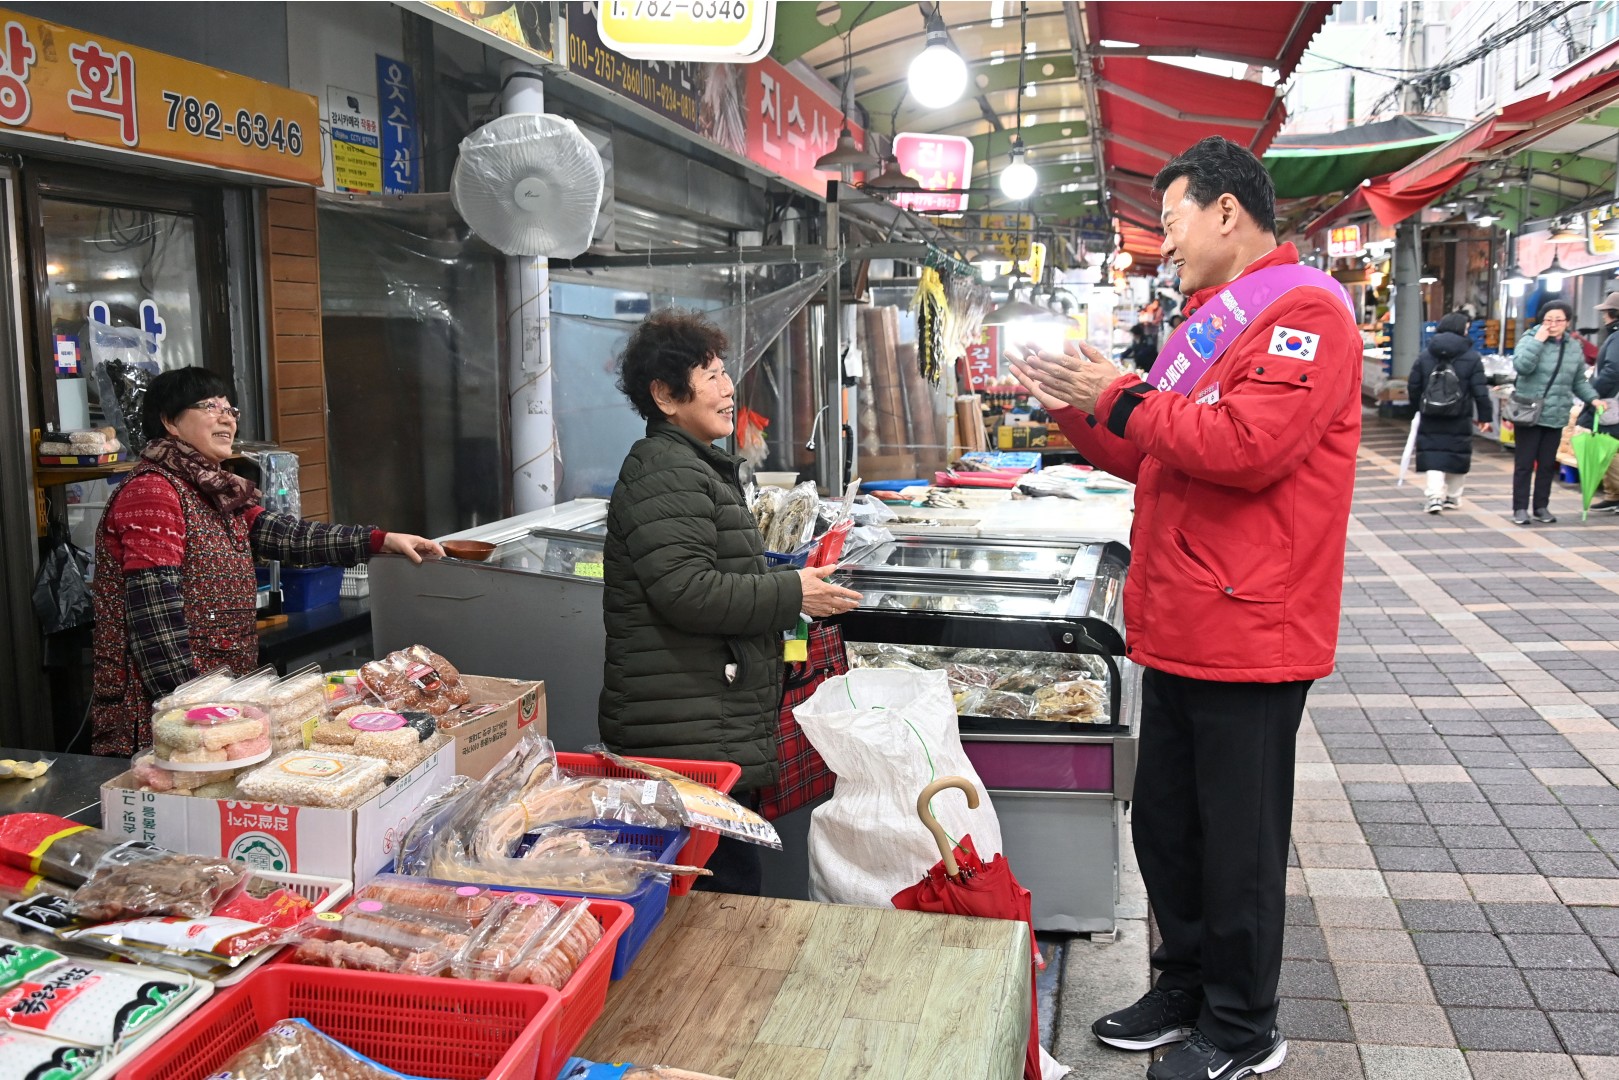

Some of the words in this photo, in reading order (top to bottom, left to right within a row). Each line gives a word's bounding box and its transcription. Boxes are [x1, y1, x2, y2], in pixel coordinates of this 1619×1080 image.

[162, 90, 303, 156] 782-6346
[331, 112, 360, 129] 감시카메라
[361, 118, 377, 133] 작동중
[384, 62, 412, 185] 옷수선
[122, 810, 137, 834] 손맛
[226, 811, 290, 832] 찹쌀산자
